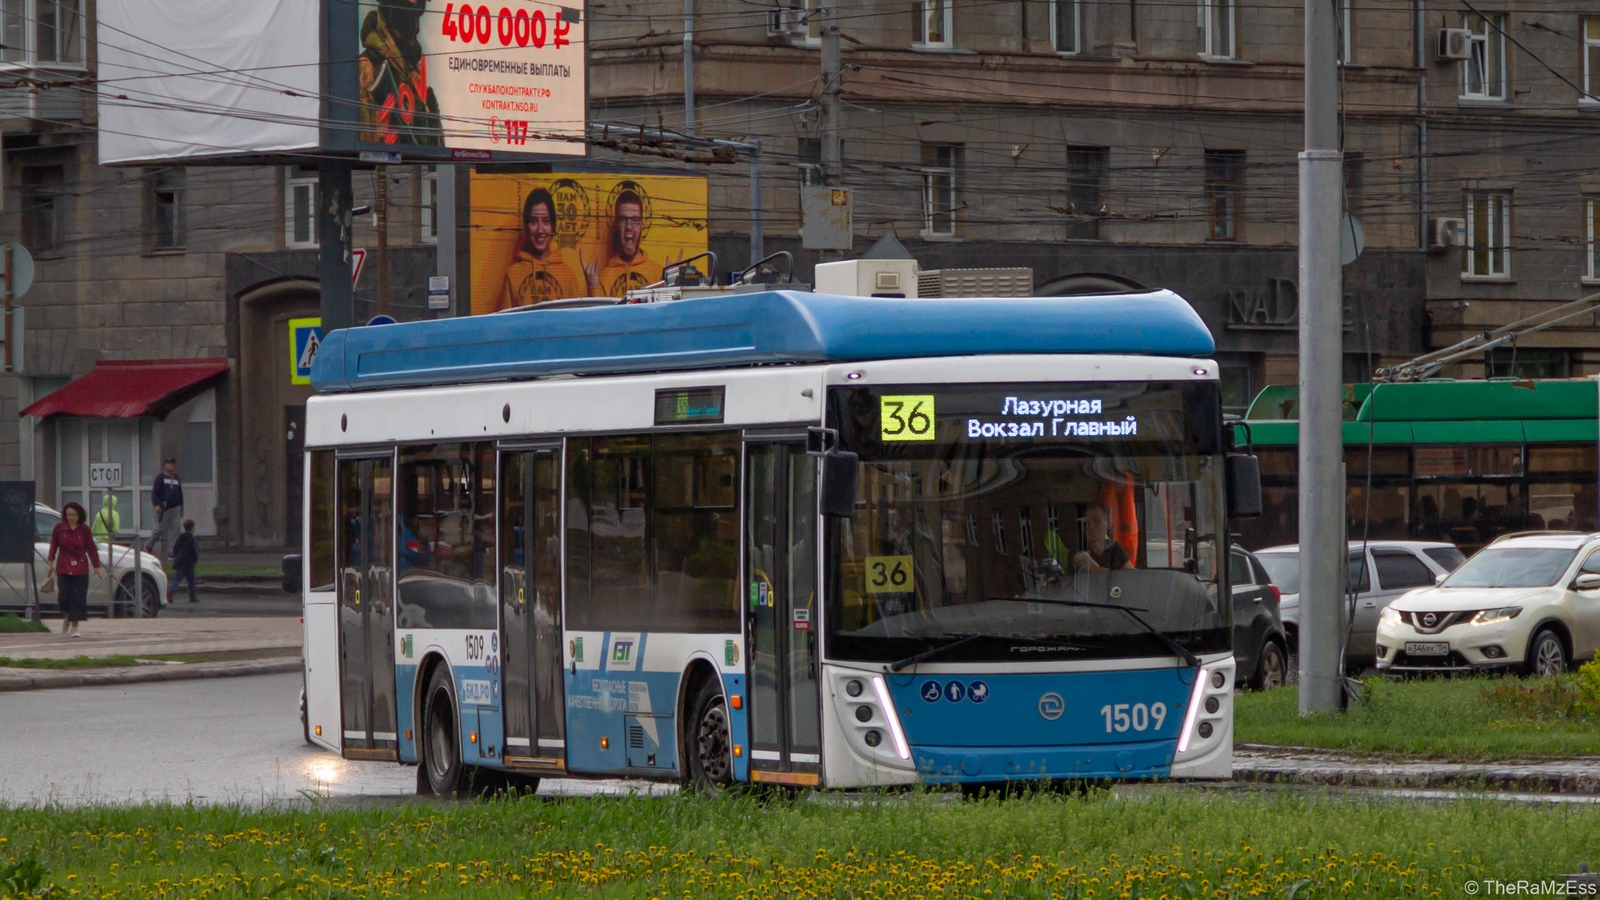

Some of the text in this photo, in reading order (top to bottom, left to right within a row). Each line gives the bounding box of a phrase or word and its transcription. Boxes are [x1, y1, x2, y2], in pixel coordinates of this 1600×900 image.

[441, 3, 491, 45] 400
[498, 7, 547, 49] 000
[448, 56, 571, 78] ЕДИНОВРЕМЕННЫЕ ВЫПЛАТЫ
[468, 83, 551, 98] СЛУЖБАПОКОНТРАКТУ.РФ
[481, 99, 538, 113] KONTRAKT.NSO.RU
[504, 119, 528, 145] 117
[556, 203, 577, 221] 30
[557, 221, 577, 233] ЛЕТ
[882, 401, 931, 435] 36
[1001, 396, 1102, 417] Лазурная
[968, 415, 1137, 438] Вокзал Главный
[871, 561, 907, 587] 36
[465, 634, 484, 660] 1509
[1100, 702, 1167, 733] 1509
